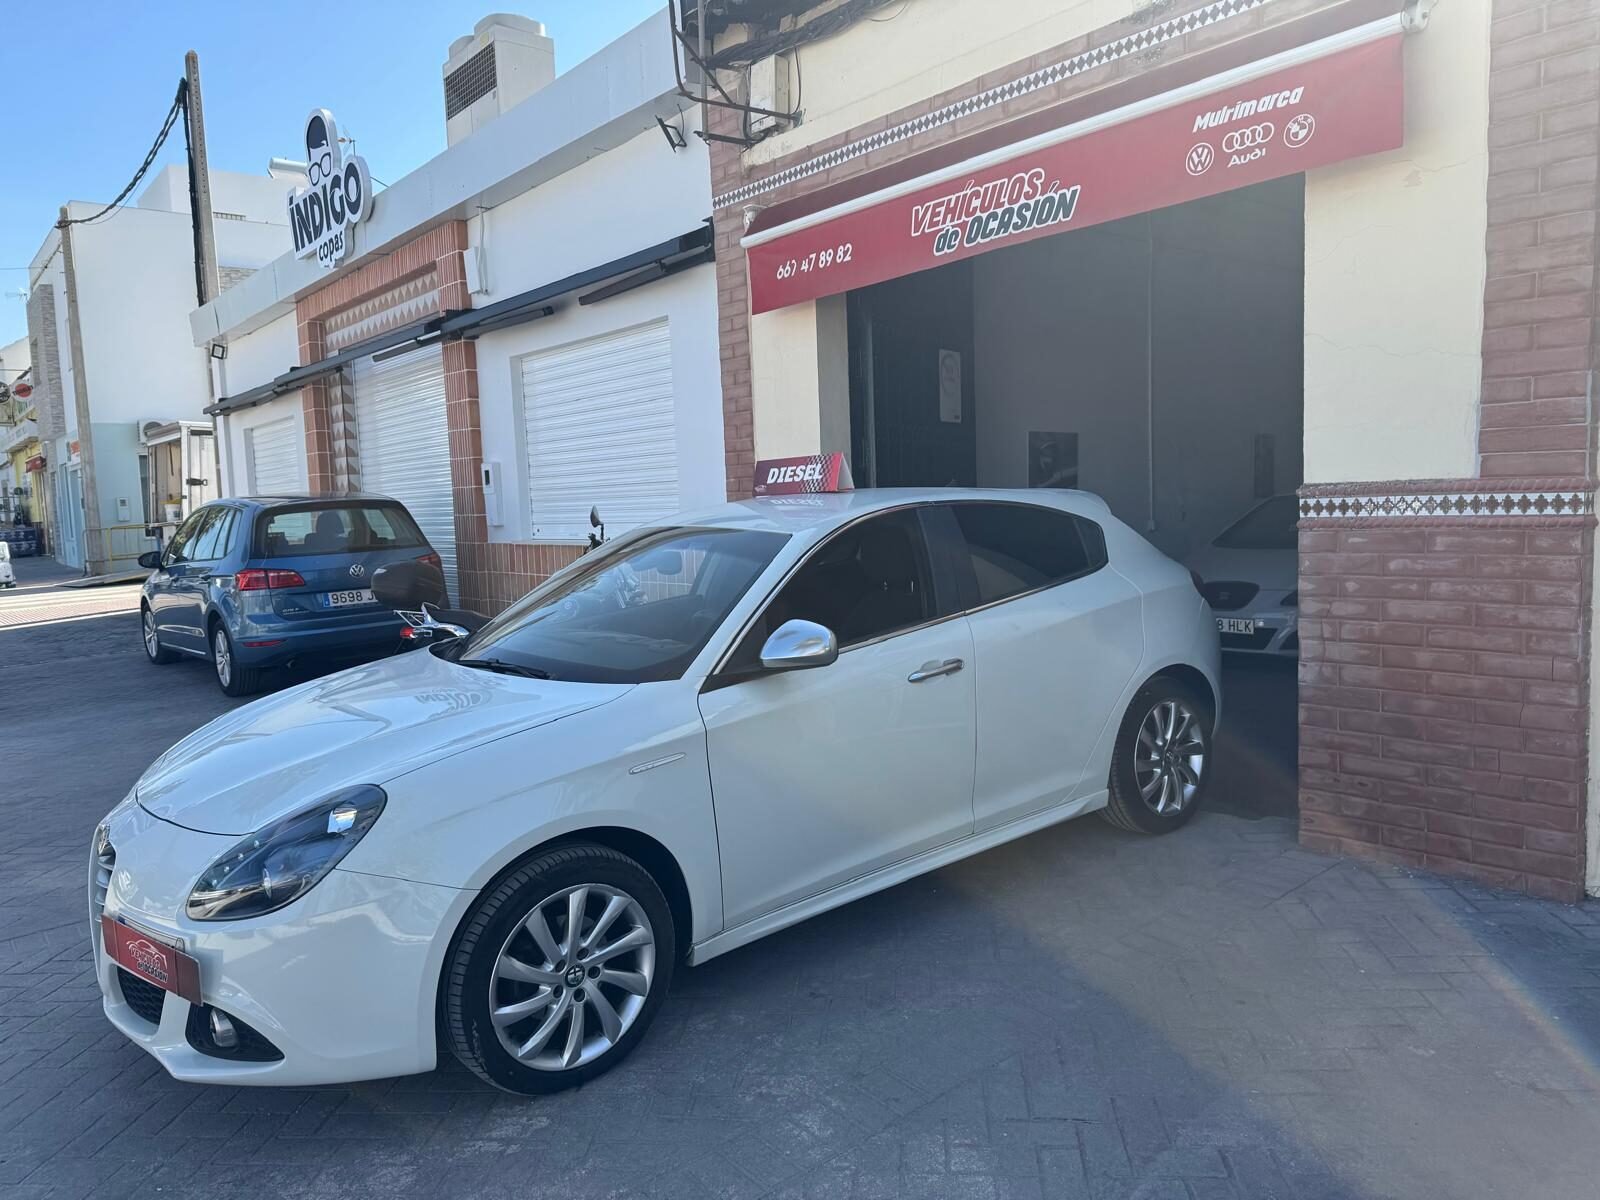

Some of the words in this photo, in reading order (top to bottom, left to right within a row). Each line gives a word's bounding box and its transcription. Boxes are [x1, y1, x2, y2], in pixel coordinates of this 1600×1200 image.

[1226, 147, 1267, 168] Audi
[318, 230, 344, 262] copas
[934, 226, 961, 256] de
[818, 248, 834, 269] 89
[836, 242, 853, 264] 82
[767, 463, 824, 484] DIESEL
[331, 591, 363, 604] 9698
[1228, 619, 1252, 633] HLK
